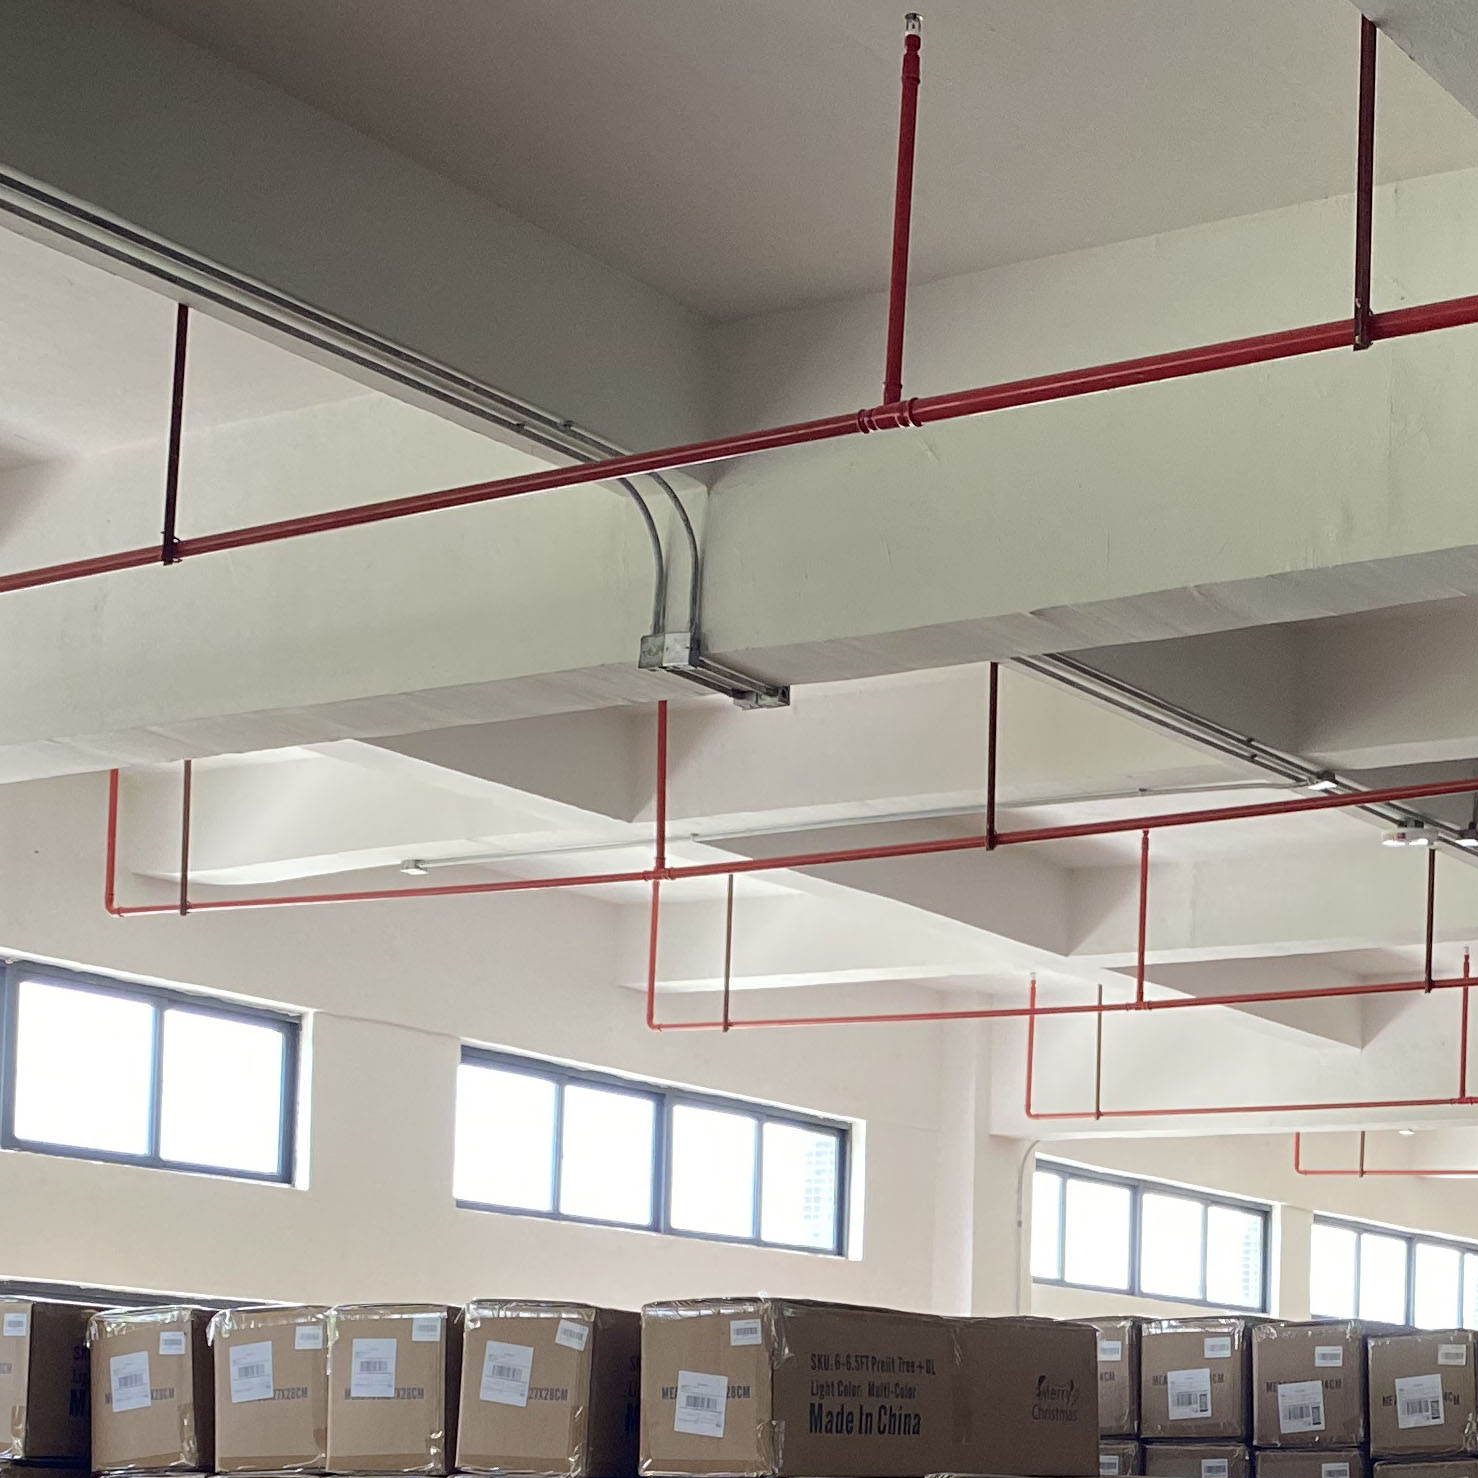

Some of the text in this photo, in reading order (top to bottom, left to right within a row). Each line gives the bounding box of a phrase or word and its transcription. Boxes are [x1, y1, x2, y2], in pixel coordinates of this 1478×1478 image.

[811, 1380, 834, 1400] Light
[868, 1382, 917, 1400] Multi-Color
[809, 1402, 854, 1435] Made
[859, 1404, 873, 1435] In
[877, 1404, 922, 1436] China
[1032, 1404, 1078, 1422] Christmas
